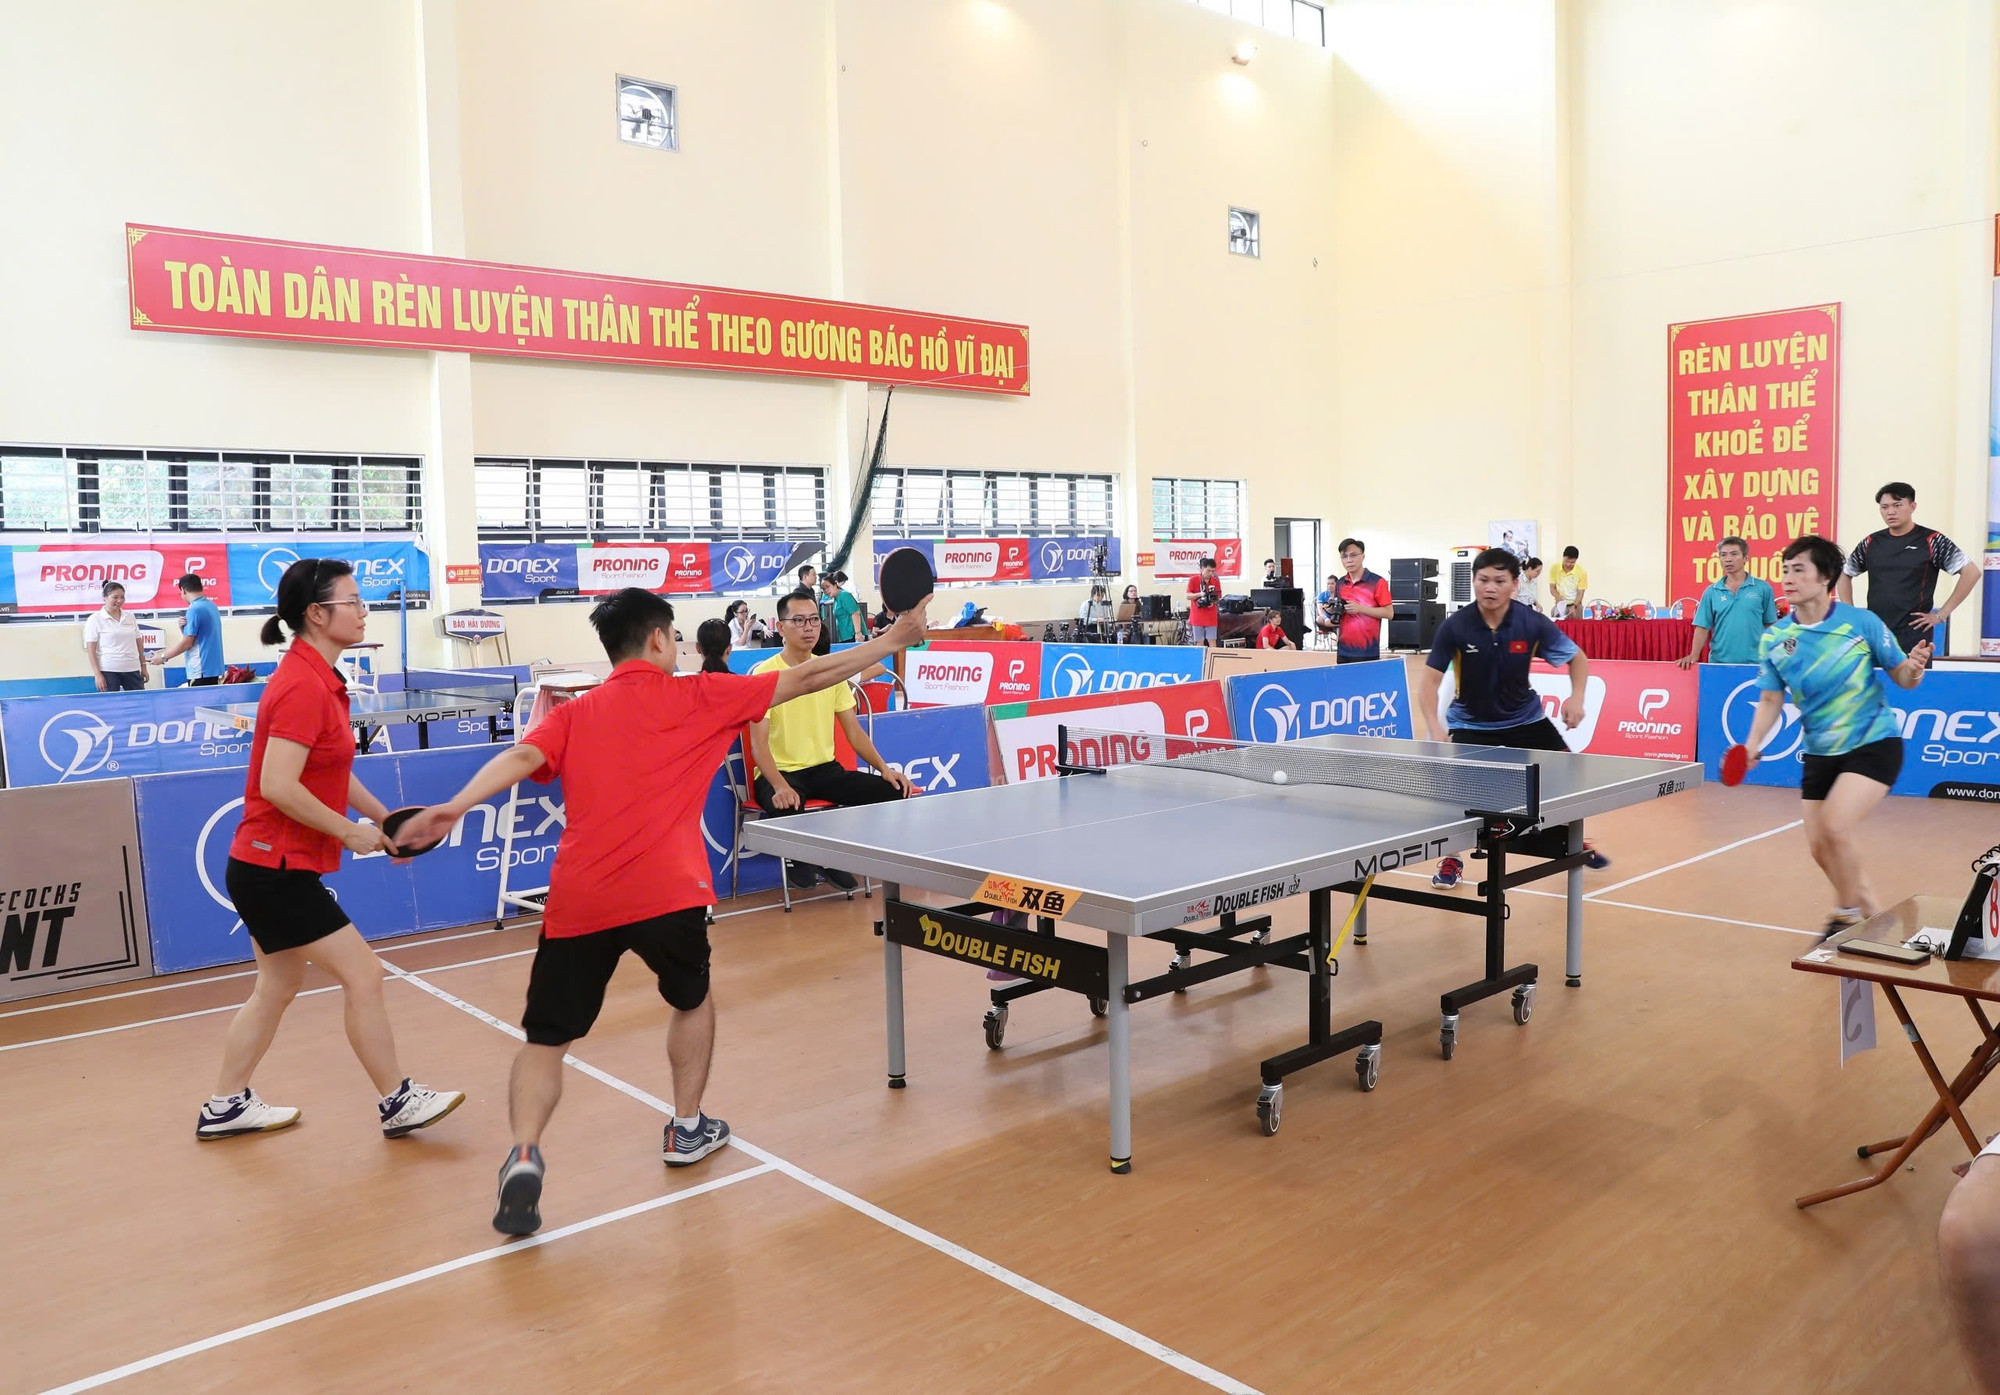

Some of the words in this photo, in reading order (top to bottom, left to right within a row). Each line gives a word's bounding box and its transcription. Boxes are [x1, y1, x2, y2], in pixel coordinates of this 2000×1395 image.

[164, 256, 271, 317] TOÀN
[283, 265, 361, 324] DÂN
[371, 272, 442, 329] RÈN
[452, 285, 554, 345] LUYỆN
[562, 294, 640, 345] THÂN
[648, 295, 700, 349] THỂ
[707, 313, 772, 356] THEO
[780, 319, 861, 363] GƯƠNG
[868, 323, 914, 369] BÁC
[920, 325, 949, 372] HỒ
[954, 337, 975, 375] VĨ
[979, 343, 1014, 386] ĐẠI
[1678, 342, 1731, 376] RÈN
[1740, 330, 1828, 370] LUYỆN
[1687, 382, 1757, 417] THÂN
[1765, 368, 1819, 410] THỂ
[1694, 419, 1764, 458] KHOẺ
[1772, 413, 1811, 453] ĐỂ
[1683, 468, 1735, 501] XÂY
[1743, 467, 1819, 503] DỰNG
[1681, 510, 1714, 542] VÀ
[1723, 505, 1777, 541] BẢO
[40, 563, 147, 582] PRONING
[486, 557, 561, 574] DONEX
[524, 573, 557, 585] Sport
[592, 559, 659, 572] PRONING
[361, 577, 402, 588] Sport
[917, 664, 983, 683] PRONING
[406, 708, 477, 723] MOFIT
[1310, 690, 1398, 730] DONEX
[1892, 707, 2000, 743] NEX
[457, 718, 508, 735] Spot
[1617, 721, 1682, 735] PRONING
[1921, 744, 2000, 767] Spor
[475, 844, 560, 874] Spor
[1354, 837, 1449, 878] MOFIT
[1018, 886, 1066, 916] 双鱼
[1213, 888, 1260, 916] DOUBLE
[1260, 881, 1285, 903] FISH
[923, 919, 1008, 966] DOUBLE
[1010, 948, 1062, 980] FISH
